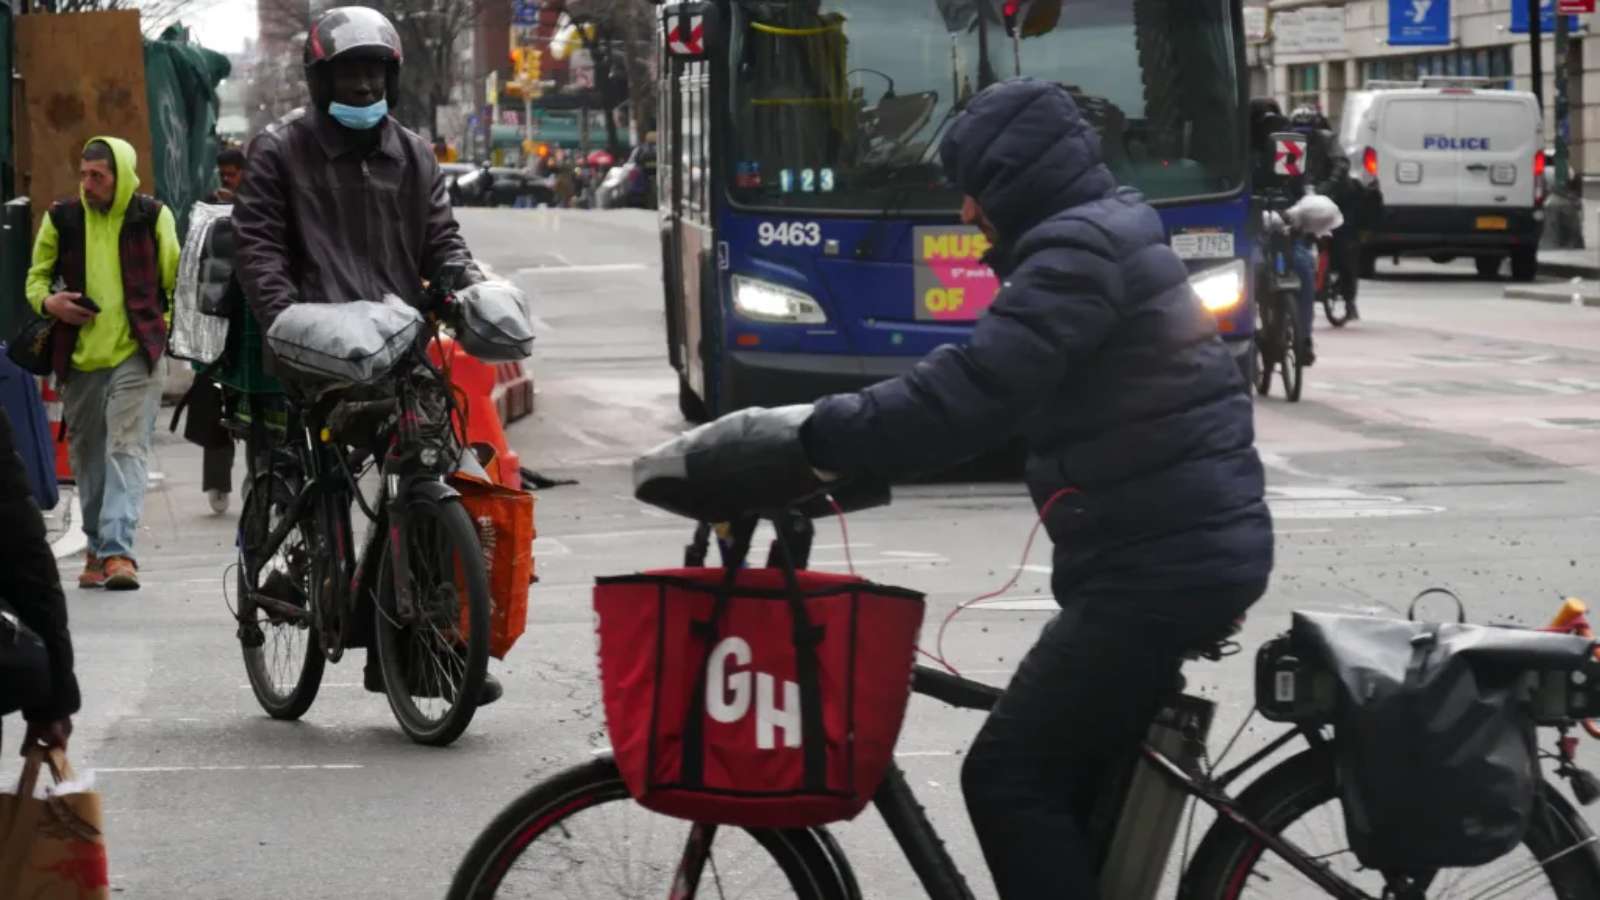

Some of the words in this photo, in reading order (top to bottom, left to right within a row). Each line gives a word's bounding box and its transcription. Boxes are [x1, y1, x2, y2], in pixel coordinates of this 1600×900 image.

[1423, 136, 1490, 150] POLICE
[758, 222, 821, 246] 9463
[925, 287, 965, 313] OF
[706, 636, 802, 749] GH
